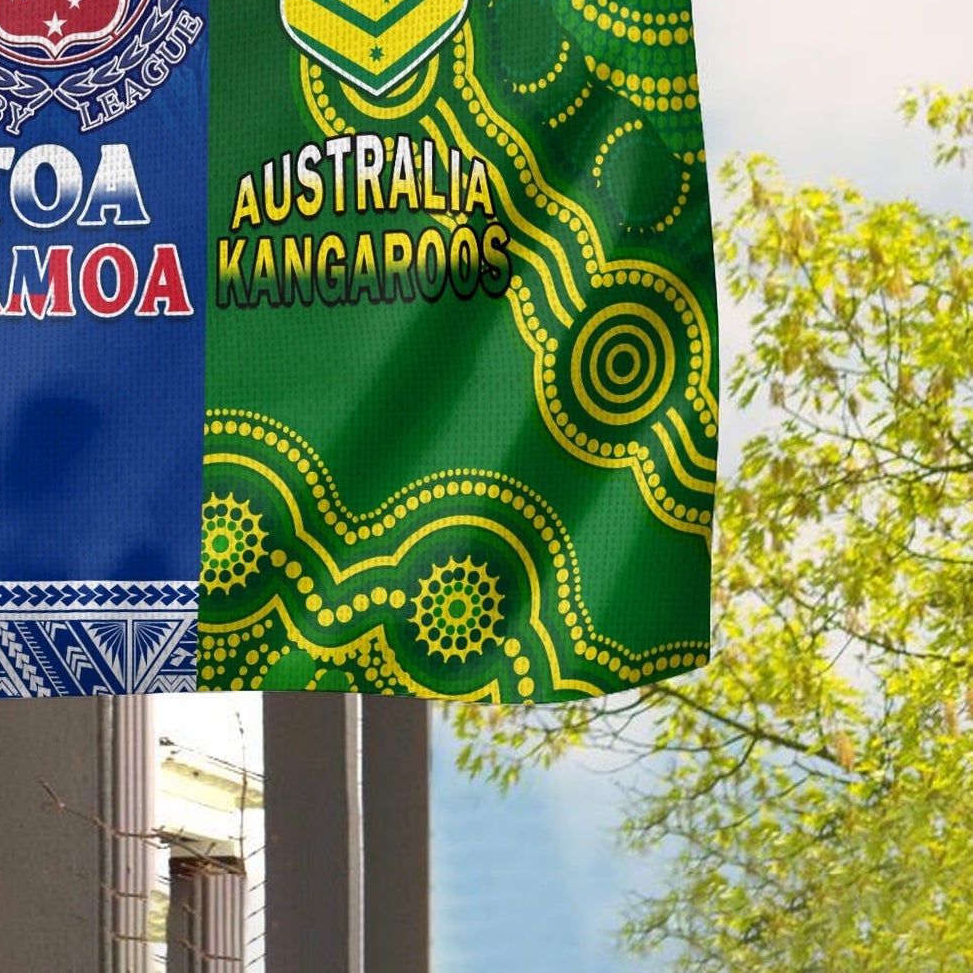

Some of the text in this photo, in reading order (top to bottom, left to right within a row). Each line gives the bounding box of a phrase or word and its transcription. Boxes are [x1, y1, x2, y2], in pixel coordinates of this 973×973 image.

[77, 10, 203, 132] LEAGUE
[229, 133, 497, 231] AUSTRALIA
[215, 217, 512, 308] KANGAROOS
